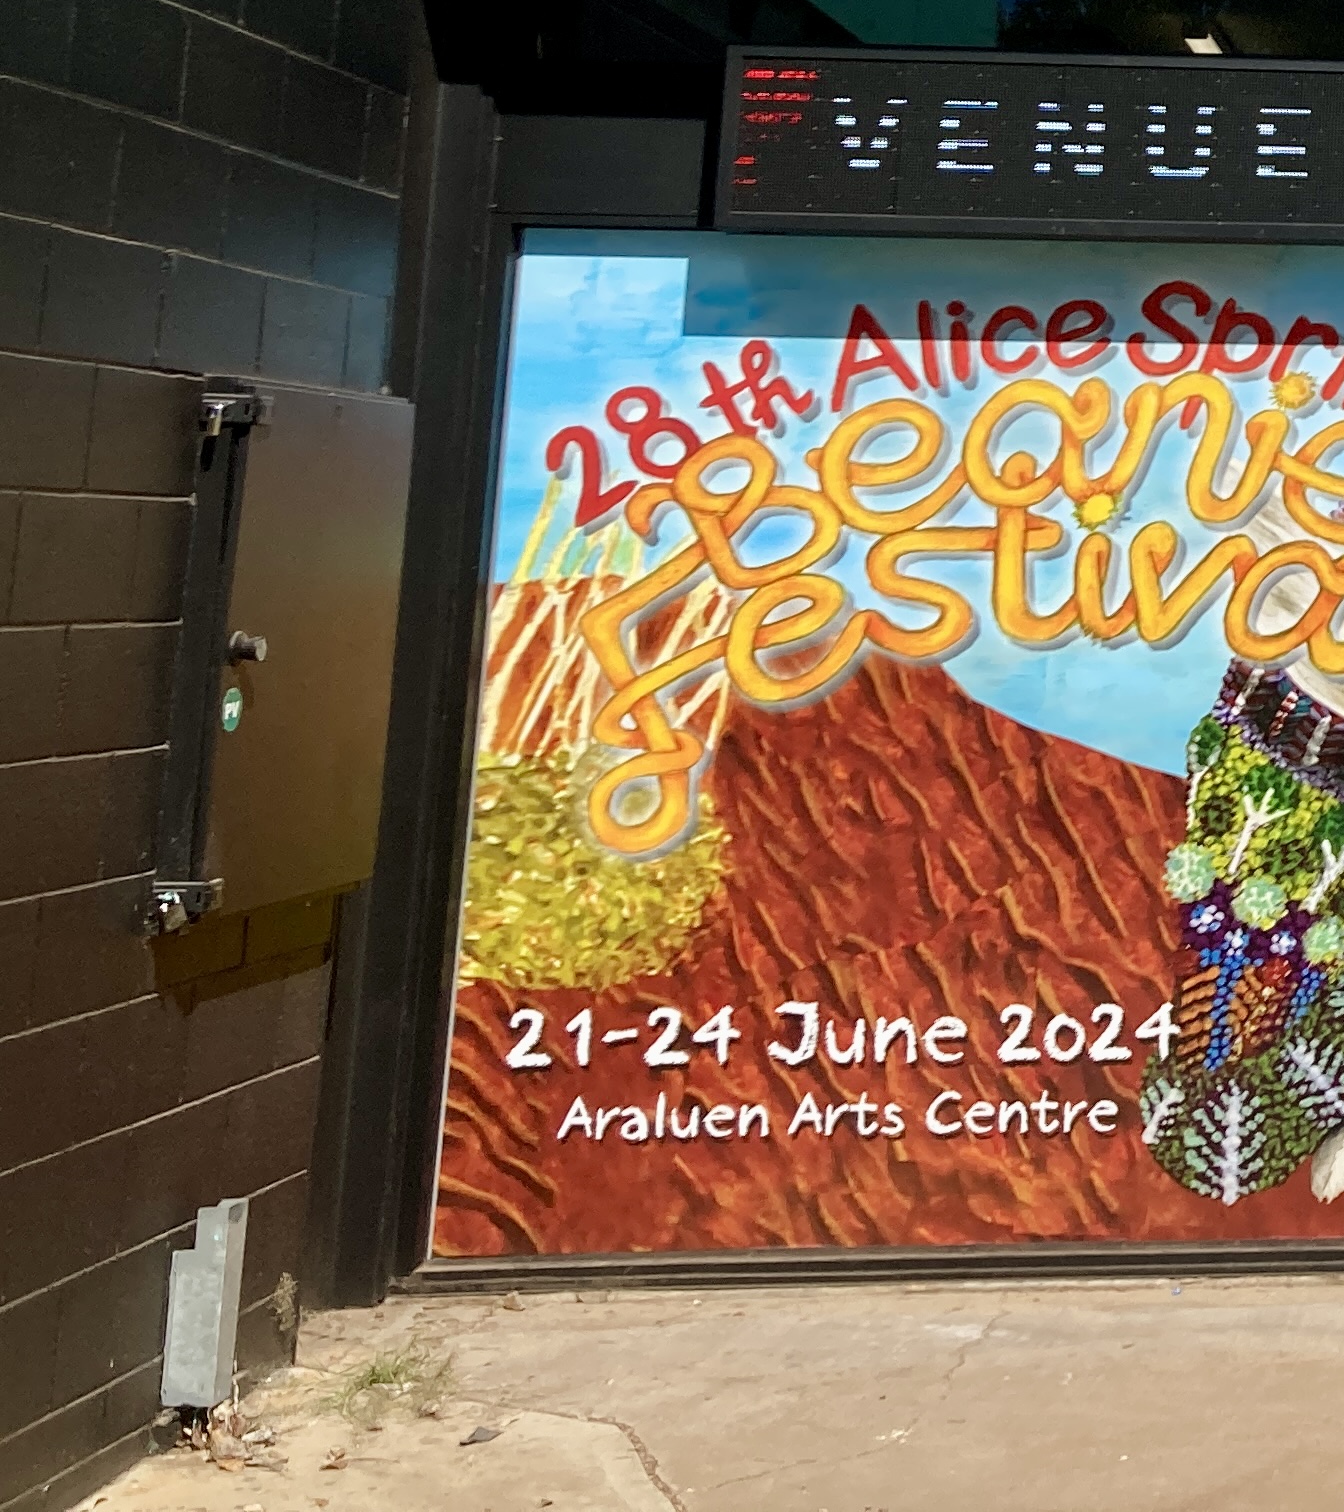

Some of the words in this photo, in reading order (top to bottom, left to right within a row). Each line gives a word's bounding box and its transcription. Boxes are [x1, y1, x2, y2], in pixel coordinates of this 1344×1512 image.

[832, 95, 1313, 180] VENUE
[828, 294, 1117, 412] Alice
[223, 700, 240, 720] PV
[504, 1003, 742, 1070] 21-24
[767, 1001, 969, 1066] June
[996, 1001, 1181, 1066] 2024
[557, 1093, 770, 1142] Araluen
[787, 1093, 904, 1140] Arts
[925, 1090, 1120, 1137] Centre
